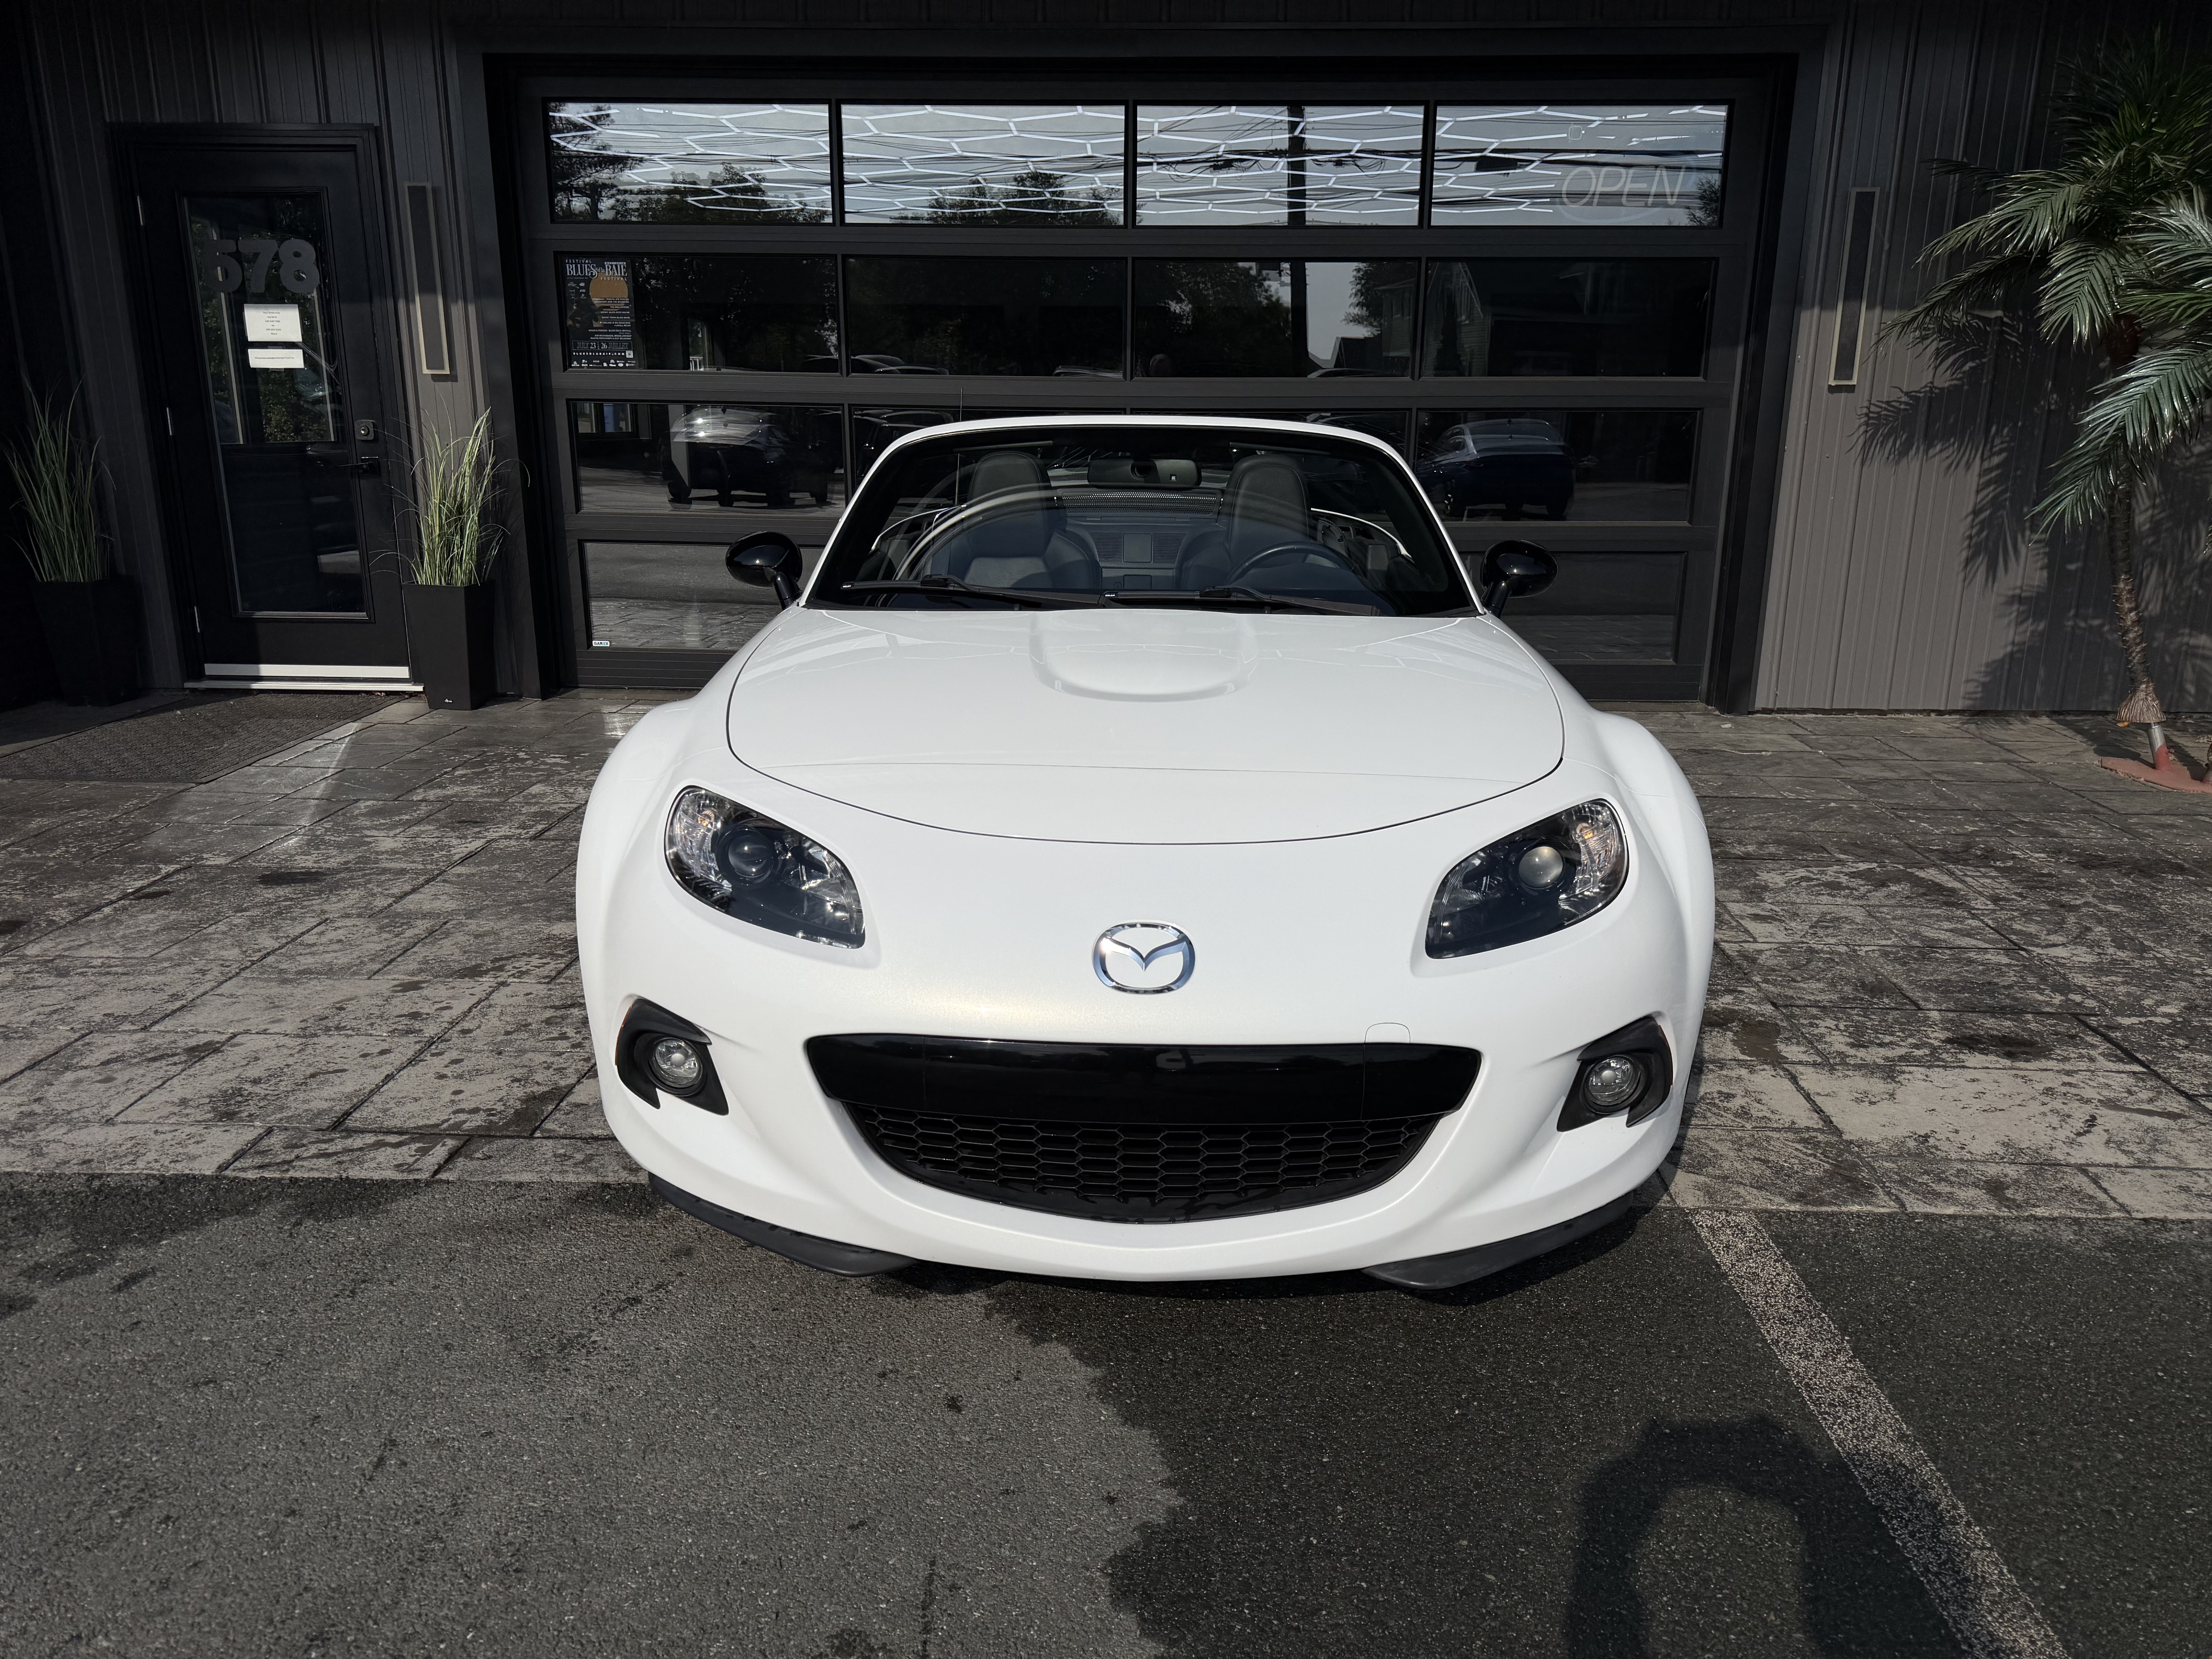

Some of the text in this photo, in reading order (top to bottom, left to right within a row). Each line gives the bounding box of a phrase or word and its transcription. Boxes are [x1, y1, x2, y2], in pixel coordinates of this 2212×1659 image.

[1561, 165, 1685, 208] OPEN
[203, 239, 320, 294] 578
[566, 264, 598, 279] BLUES
[605, 264, 627, 276] BAIE
